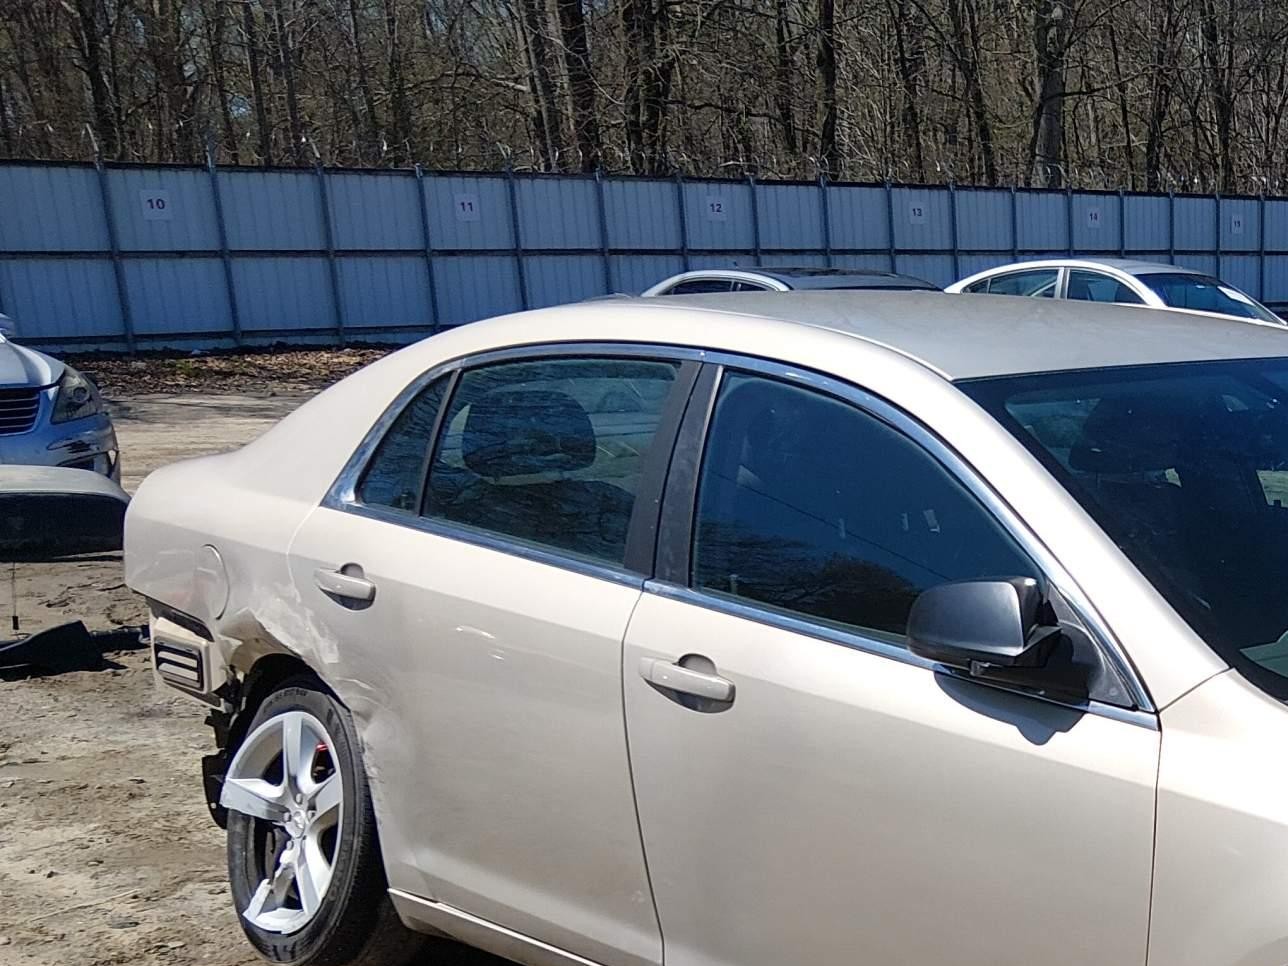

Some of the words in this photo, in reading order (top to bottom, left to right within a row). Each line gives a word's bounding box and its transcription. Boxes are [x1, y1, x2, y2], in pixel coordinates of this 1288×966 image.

[147, 198, 166, 210] 10
[460, 201, 473, 212] 11
[710, 203, 722, 213] 12
[912, 207, 923, 217] 13
